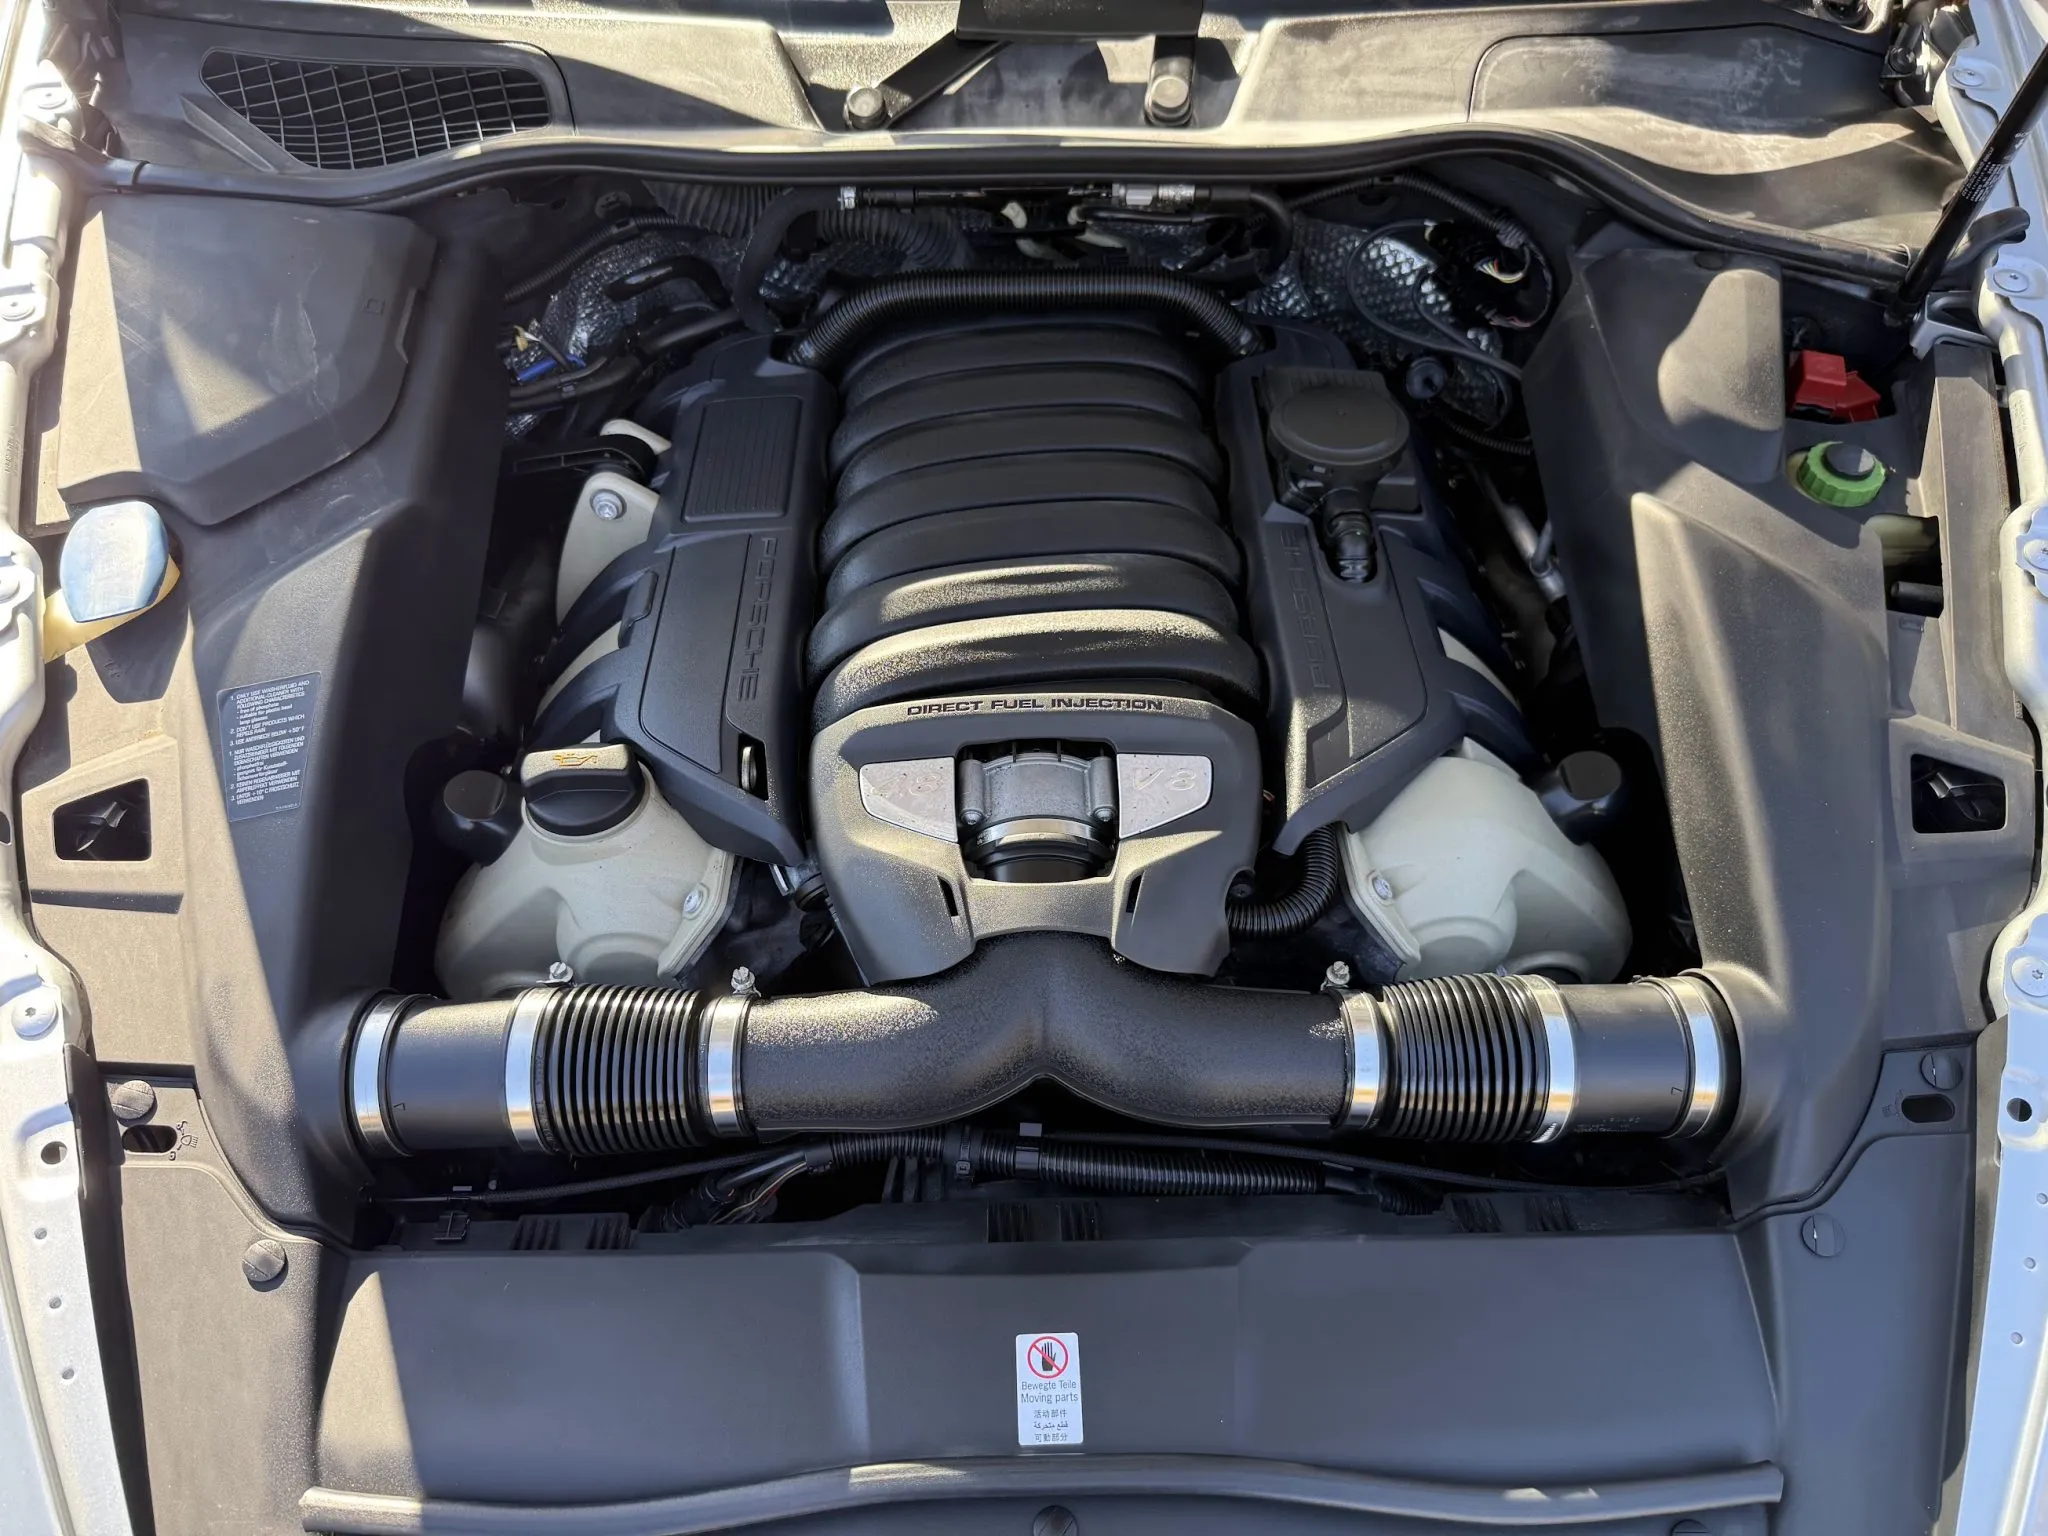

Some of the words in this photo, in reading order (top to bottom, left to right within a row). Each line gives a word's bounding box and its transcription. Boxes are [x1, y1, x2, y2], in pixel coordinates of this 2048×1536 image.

[737, 536, 778, 701] PORSCHE
[907, 701, 983, 716] DIRECT
[990, 698, 1044, 710] FUEL
[1051, 698, 1164, 711] INJECTION
[1132, 767, 1197, 791] V8
[1021, 1381, 1056, 1391] Bewegte
[1059, 1380, 1076, 1389] Teile
[1020, 1393, 1052, 1404] Moving
[1055, 1392, 1078, 1403] parts
